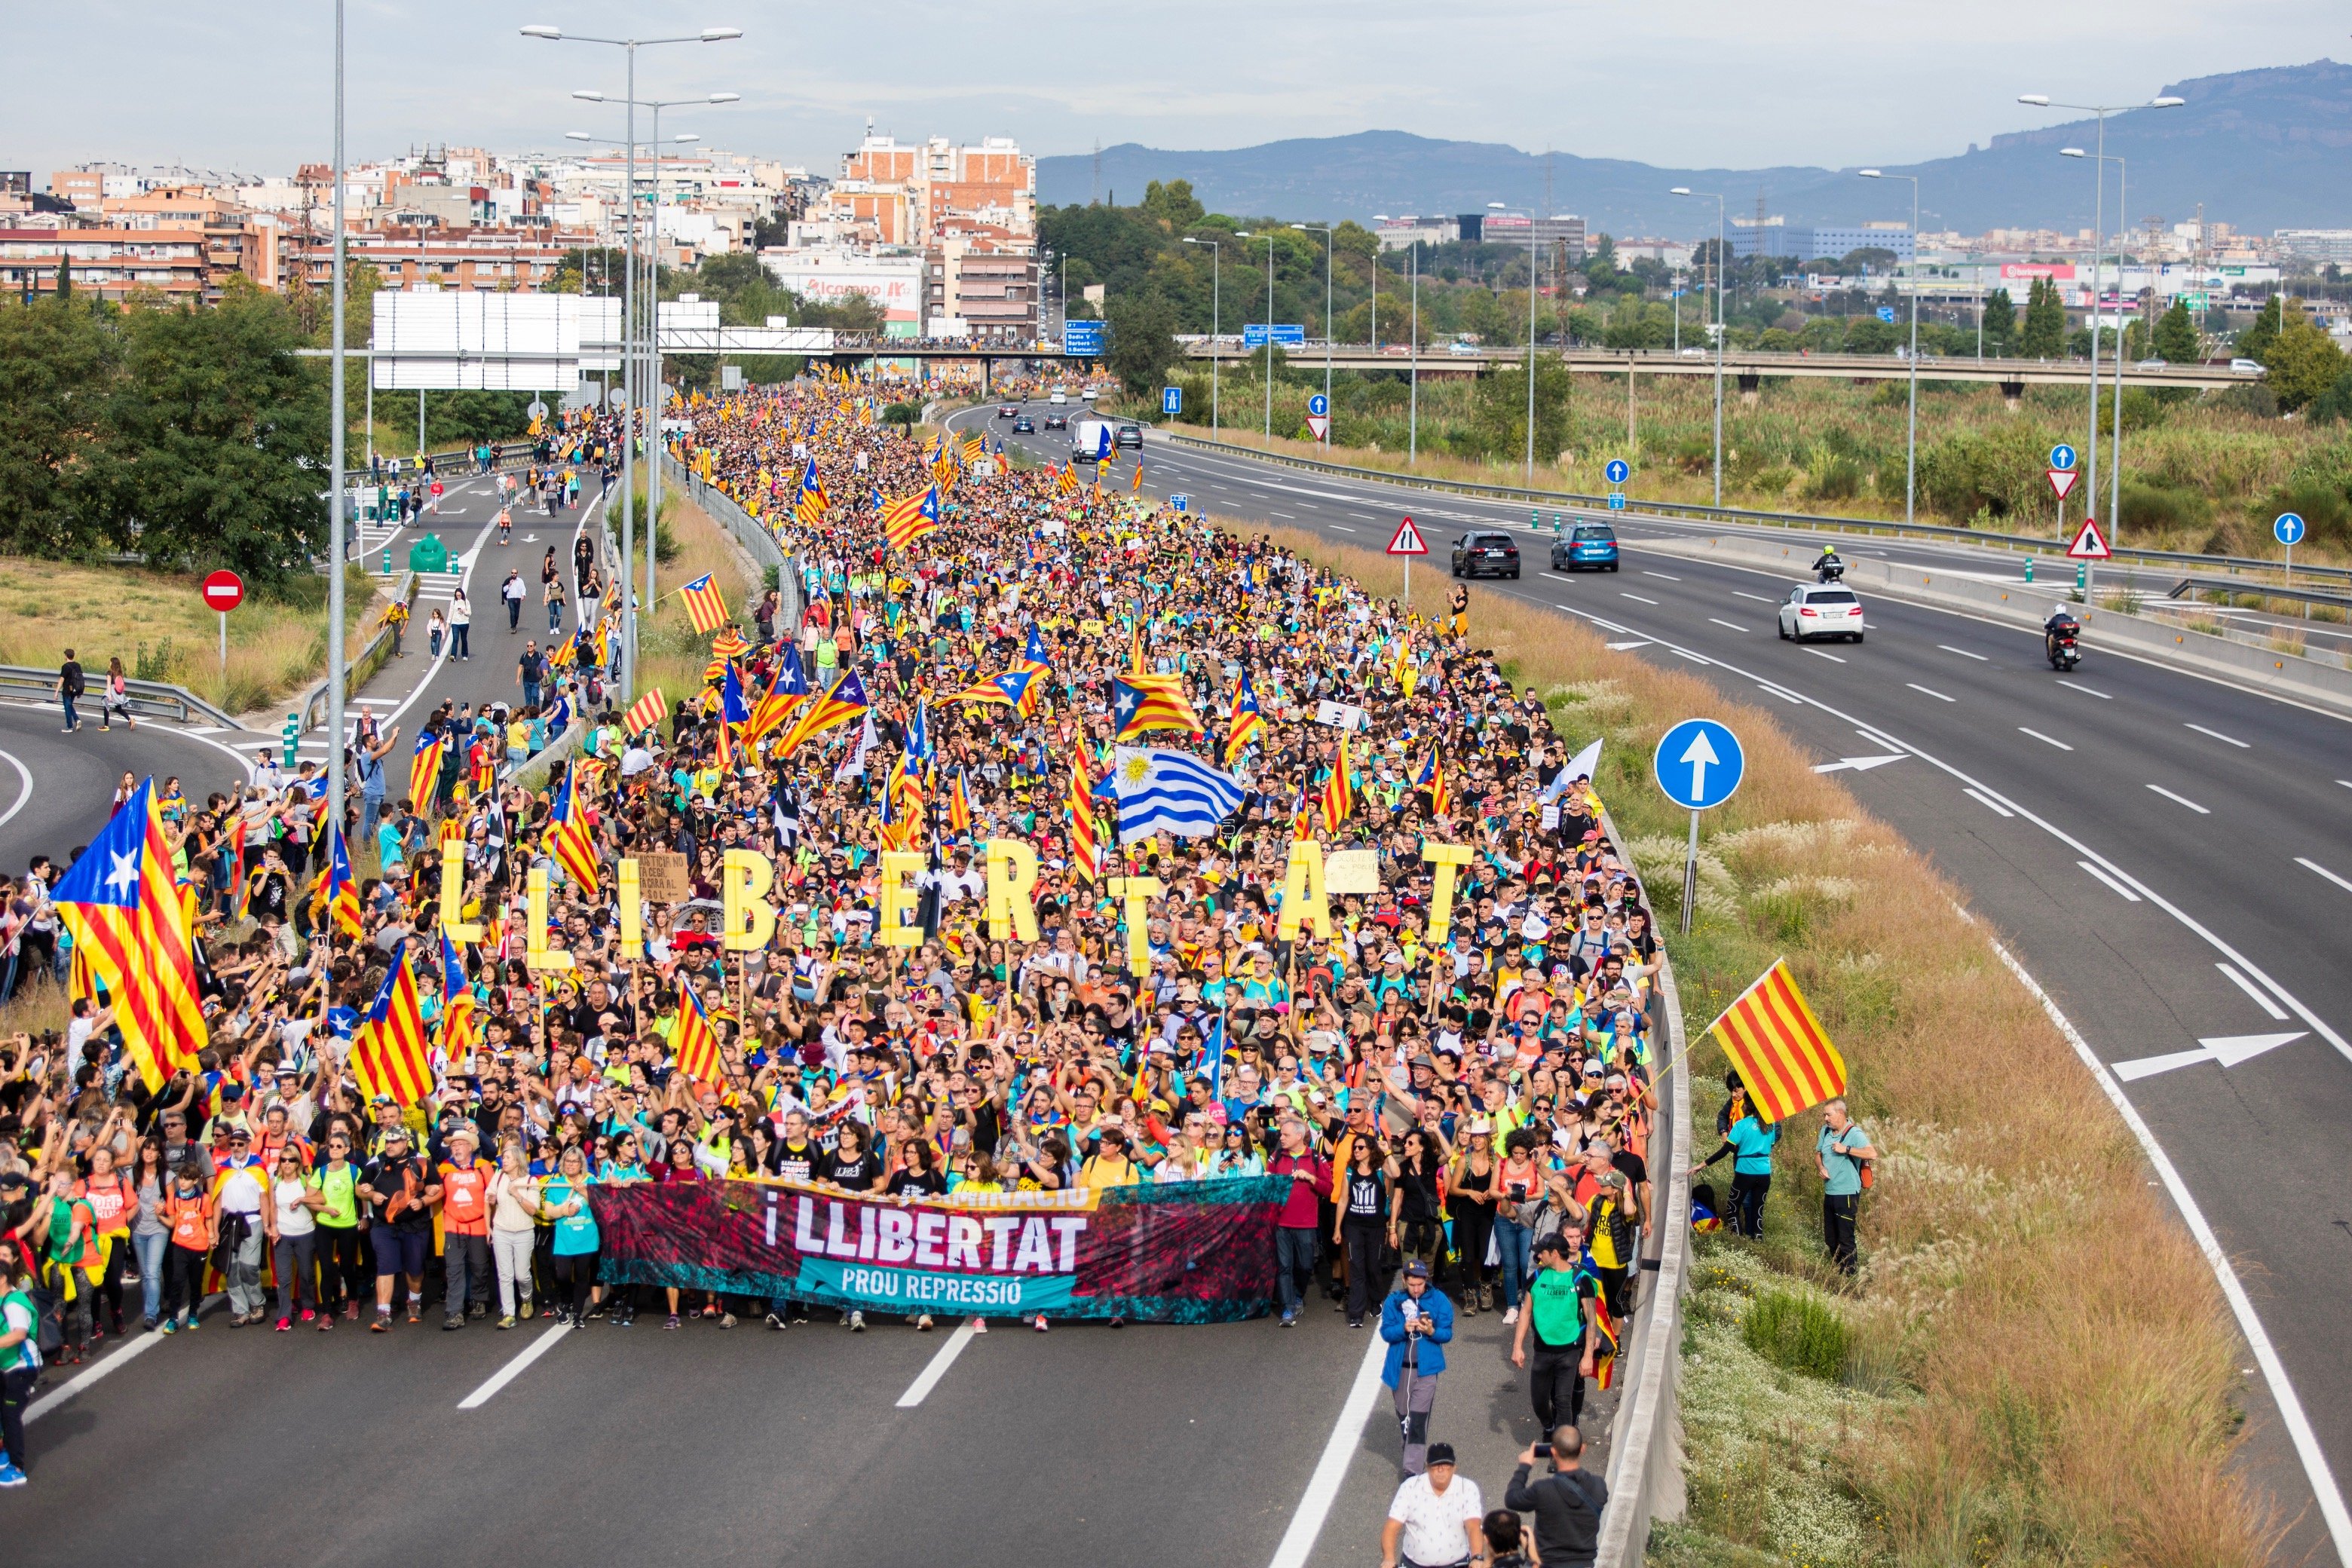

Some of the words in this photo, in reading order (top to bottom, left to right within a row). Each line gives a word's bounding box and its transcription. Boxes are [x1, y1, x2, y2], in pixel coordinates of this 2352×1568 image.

[804, 279, 881, 296] Alcampo
[672, 856, 684, 868] NO
[647, 878, 665, 889] CARA
[666, 879, 676, 889] AL
[648, 890, 665, 900] SOL
[795, 1196, 1087, 1272] LLIBERTAT
[841, 1266, 899, 1297] PROU
[905, 1274, 1021, 1305] REPRESSIÓ
